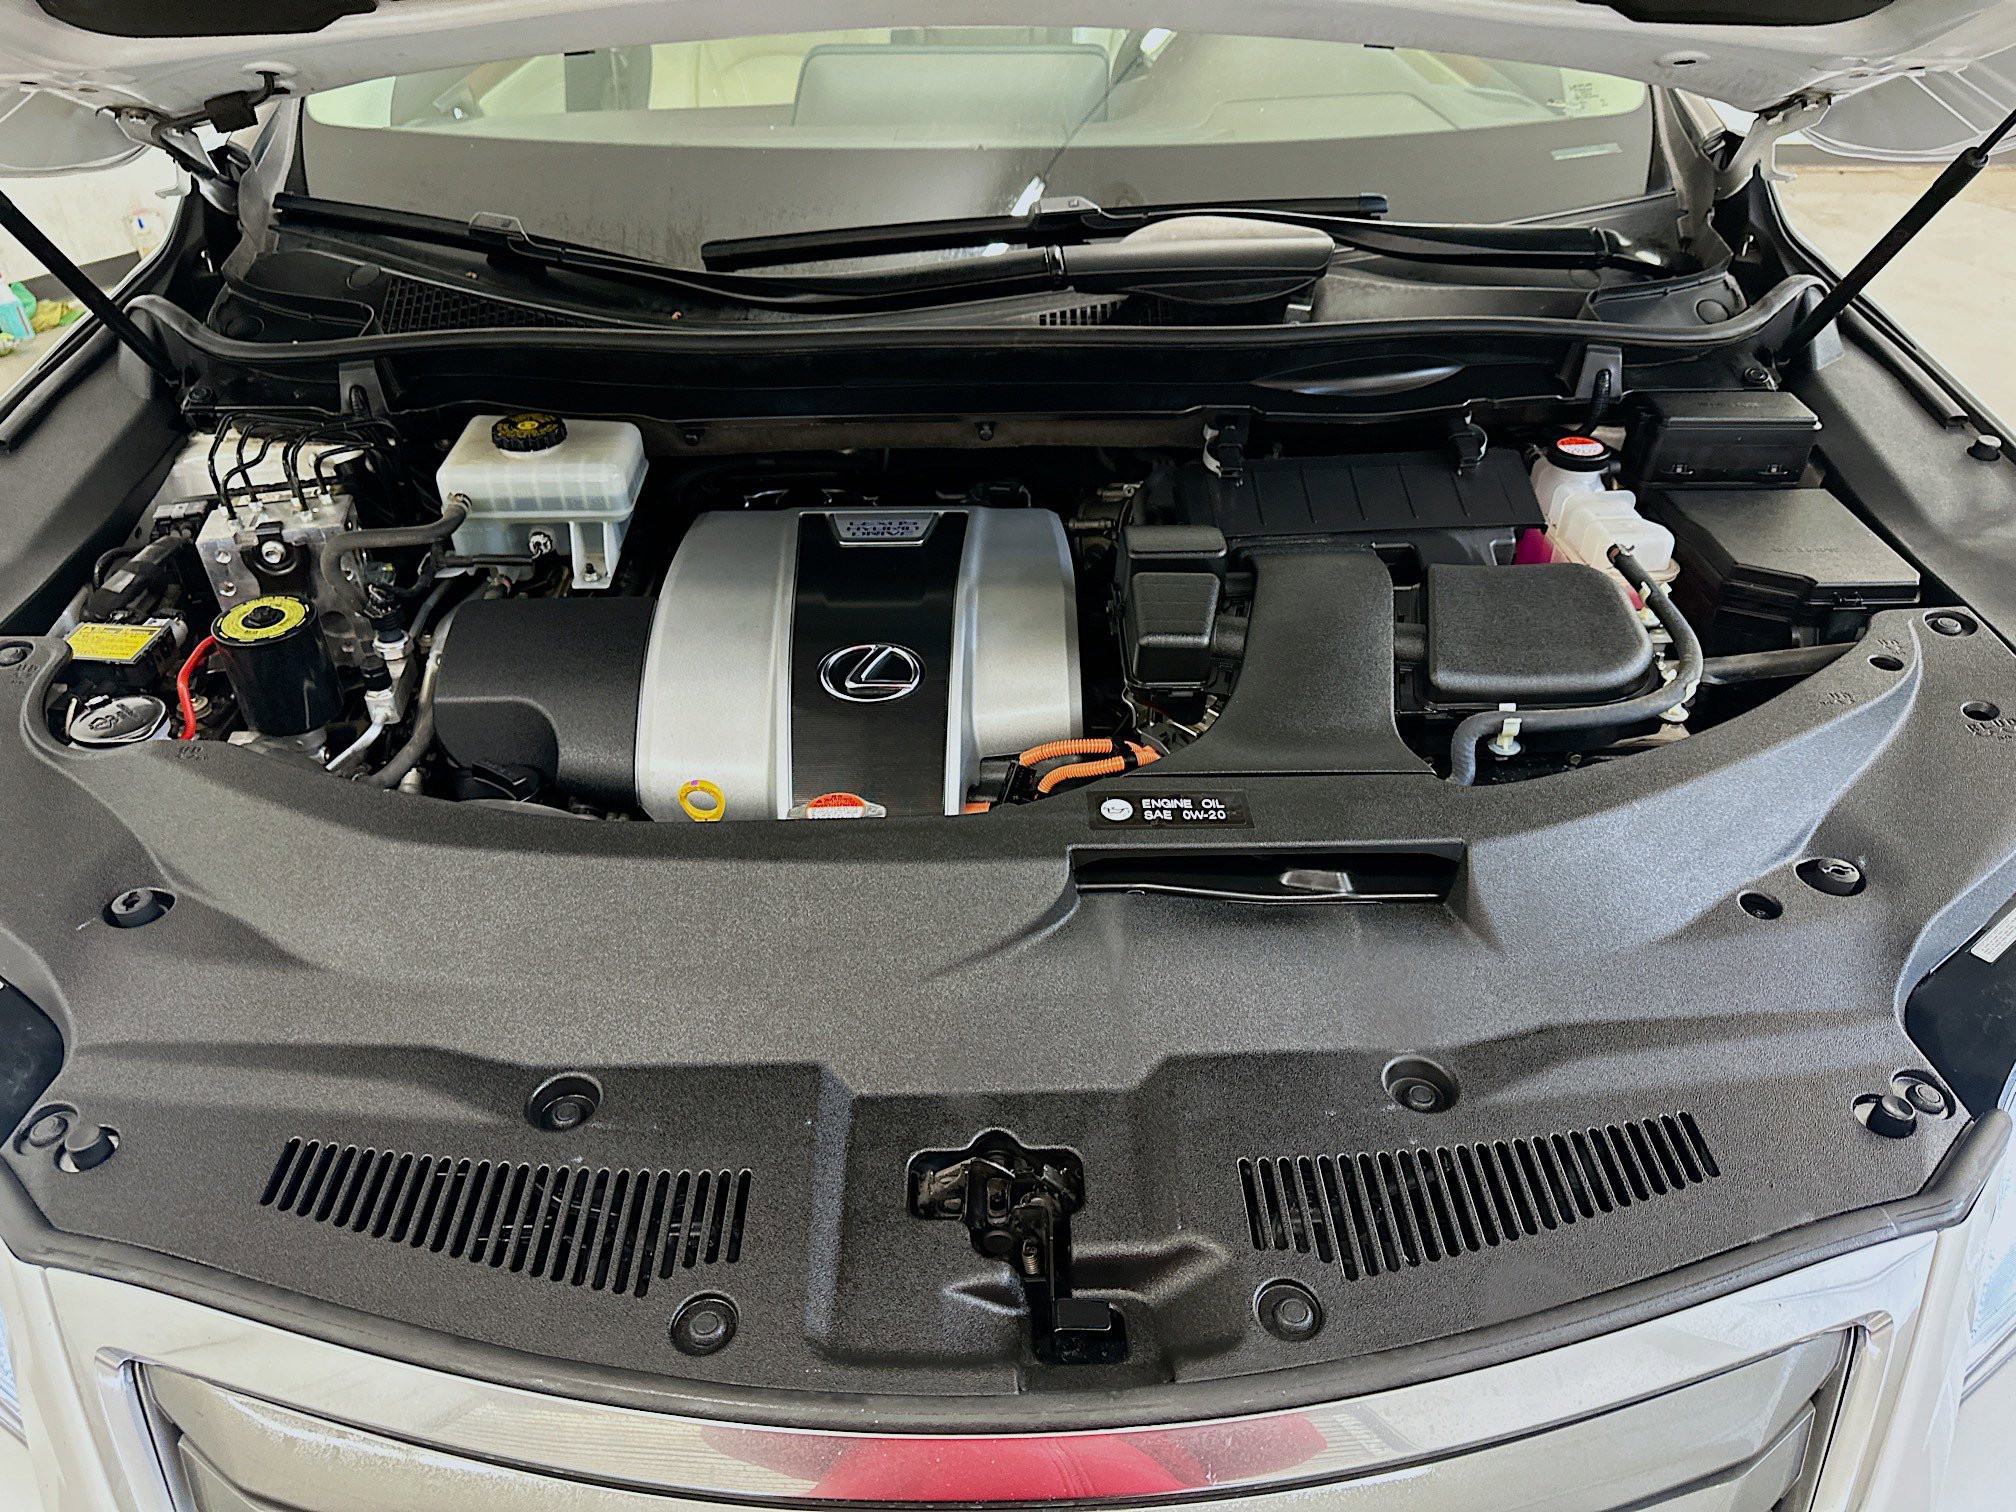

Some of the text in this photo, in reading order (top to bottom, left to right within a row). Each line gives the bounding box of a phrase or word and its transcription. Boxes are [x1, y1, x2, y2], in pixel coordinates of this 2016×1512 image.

[1142, 798, 1225, 809] ENGINE OIL
[1144, 809, 1227, 820] SAE 0W-20
